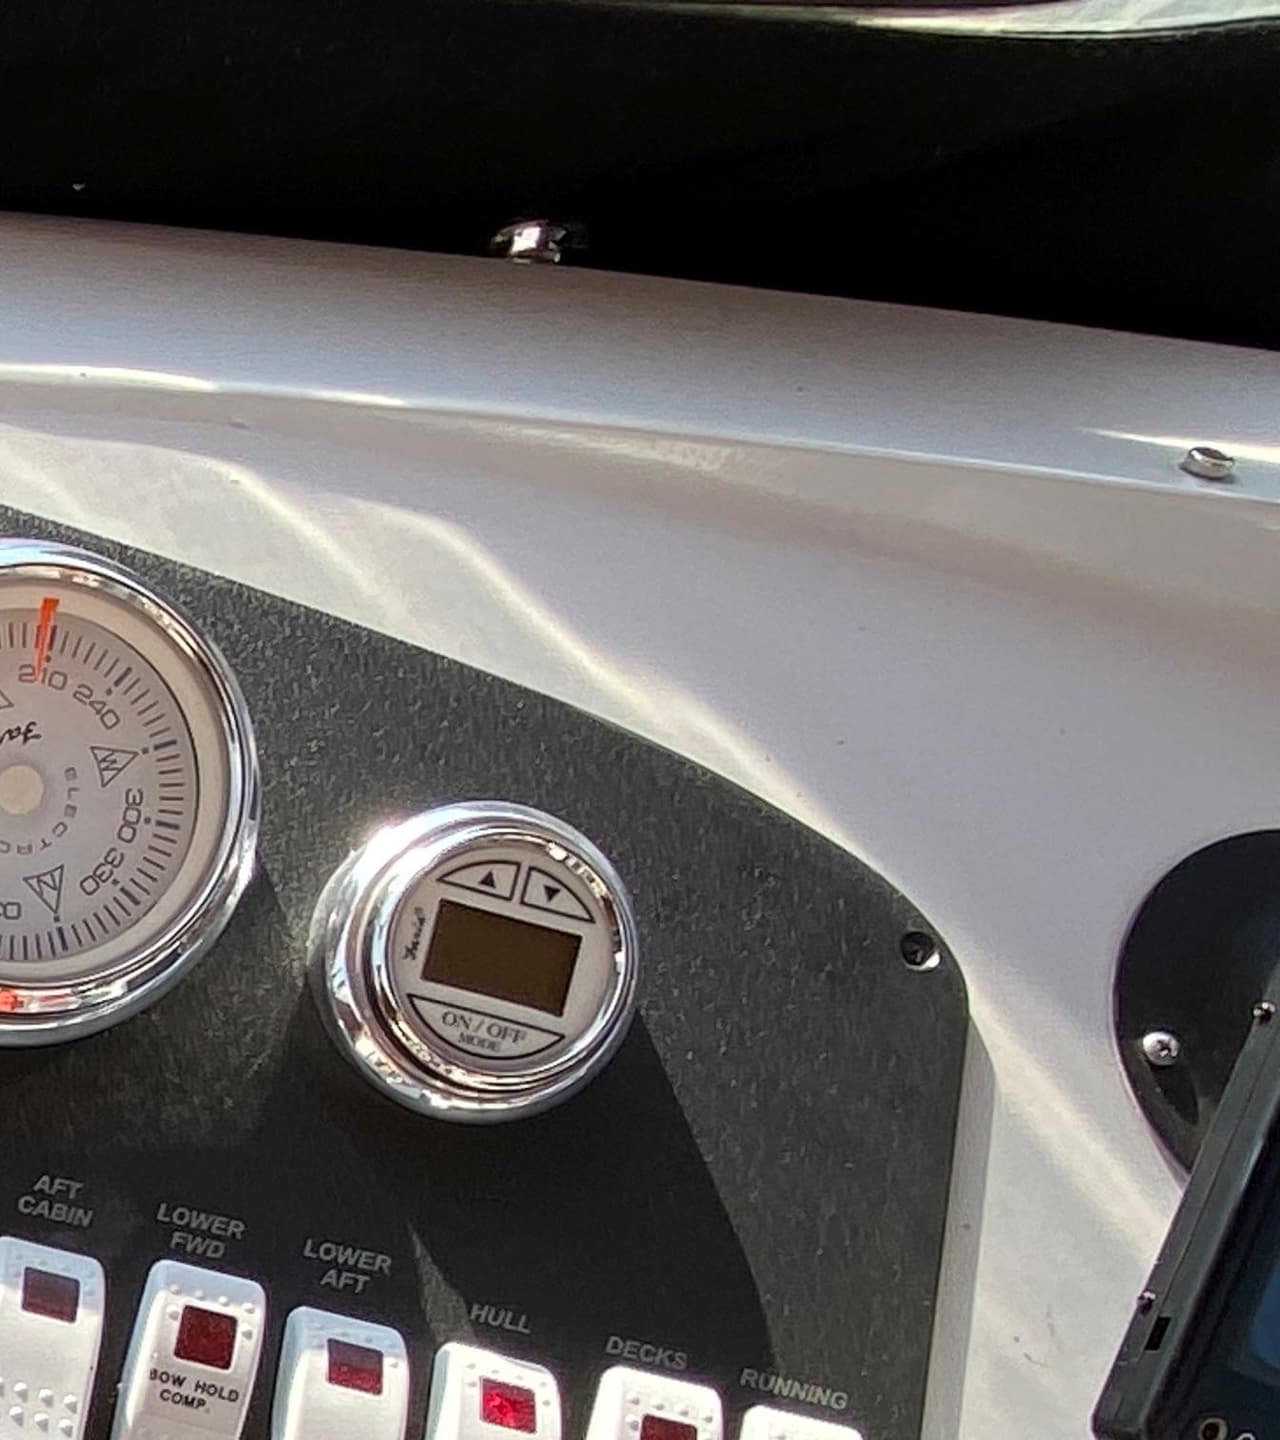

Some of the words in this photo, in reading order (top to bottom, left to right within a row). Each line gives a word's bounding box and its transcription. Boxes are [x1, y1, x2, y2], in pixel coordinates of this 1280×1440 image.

[19, 664, 67, 691] 210
[73, 683, 120, 730] 240
[118, 787, 143, 843] 300
[79, 847, 125, 897] 330
[442, 1011, 473, 1032] ON
[486, 1023, 527, 1045] OFF
[459, 1032, 501, 1050] MODE
[33, 1175, 84, 1200] AFT
[18, 1195, 93, 1228] CABIN
[157, 1202, 246, 1240] LOWER
[170, 1231, 225, 1259] FWD
[303, 1238, 392, 1274] LOWER
[321, 1273, 371, 1295] AFT
[470, 1304, 531, 1334] HULL
[606, 1336, 688, 1369] DECKS
[149, 1369, 187, 1388] BOW
[194, 1380, 240, 1402] HOLD
[741, 1368, 848, 1410] RUNNING
